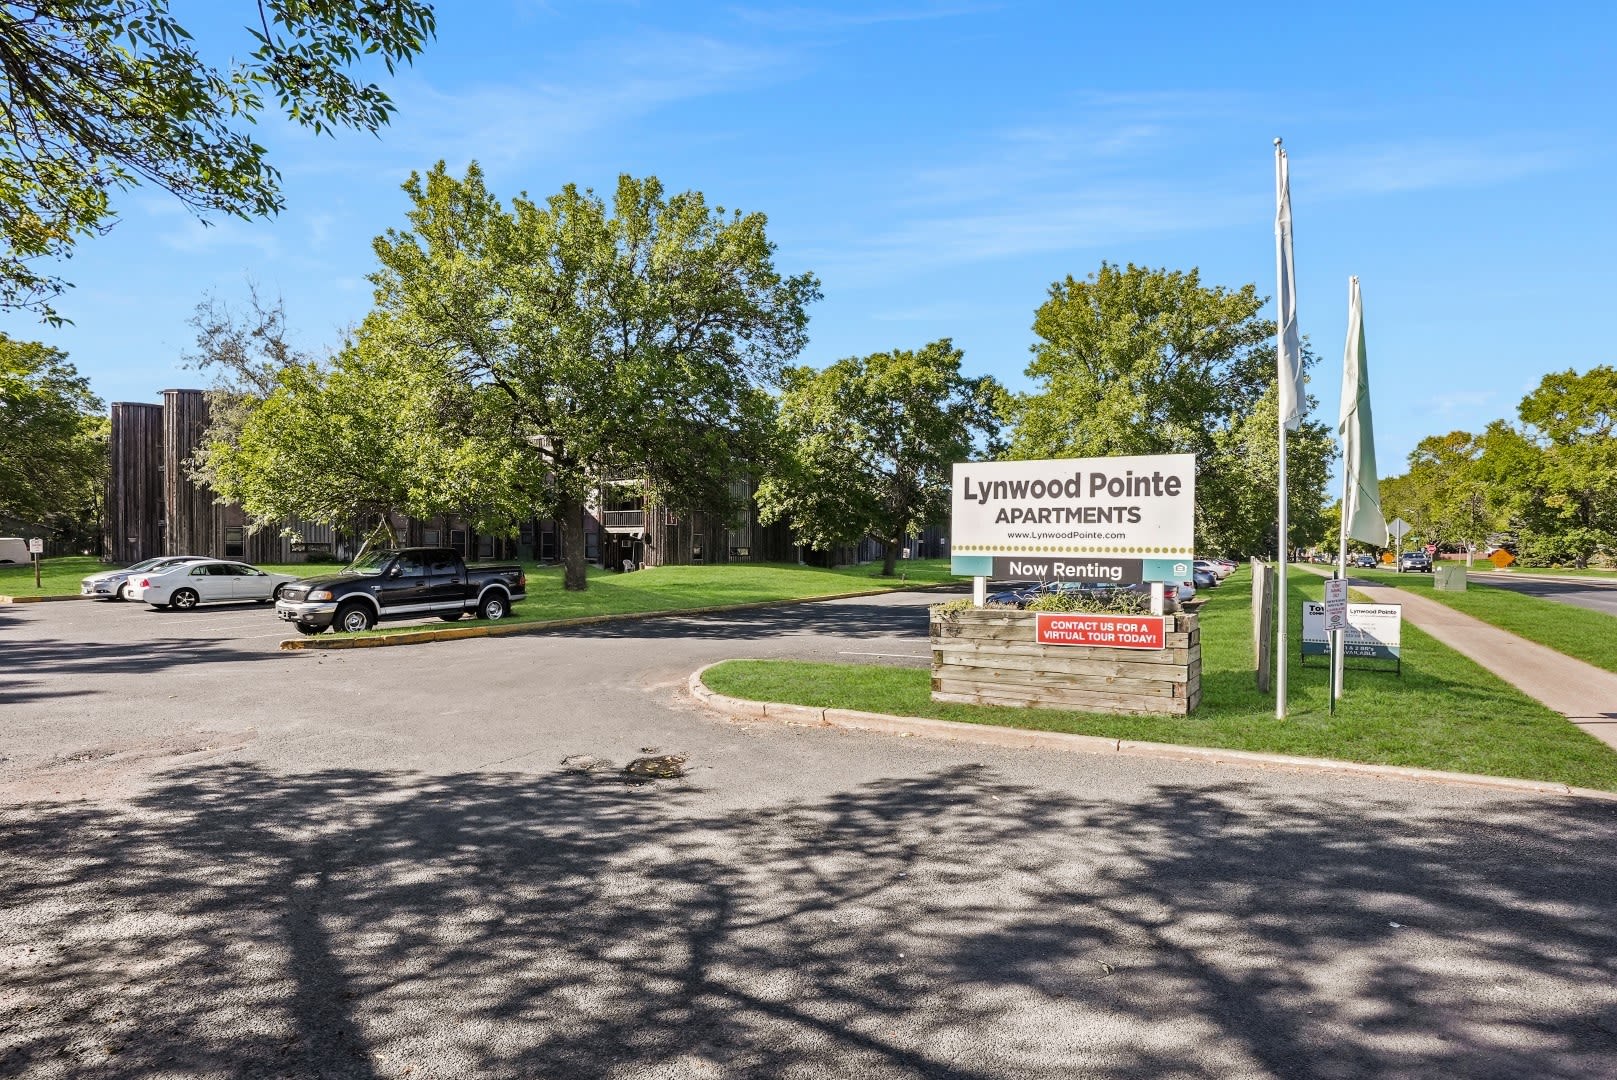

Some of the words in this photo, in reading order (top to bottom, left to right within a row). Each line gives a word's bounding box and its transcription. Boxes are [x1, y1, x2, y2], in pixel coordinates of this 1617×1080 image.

[963, 471, 1081, 505] Lynwood
[1089, 470, 1182, 498] Pointe
[994, 505, 1142, 524] APARTMENTS
[1007, 530, 1126, 540] www.LynwoodPointe.com
[1008, 561, 1049, 576] Now
[1053, 562, 1123, 581] Renting
[1050, 620, 1098, 631] CONTACT
[1100, 622, 1115, 632] US
[1116, 623, 1138, 633] FOR
[1139, 624, 1149, 633] A
[1043, 630, 1086, 641] VIRTUAL
[1088, 632, 1116, 642] TOUR
[1117, 633, 1157, 644] TODAY!
